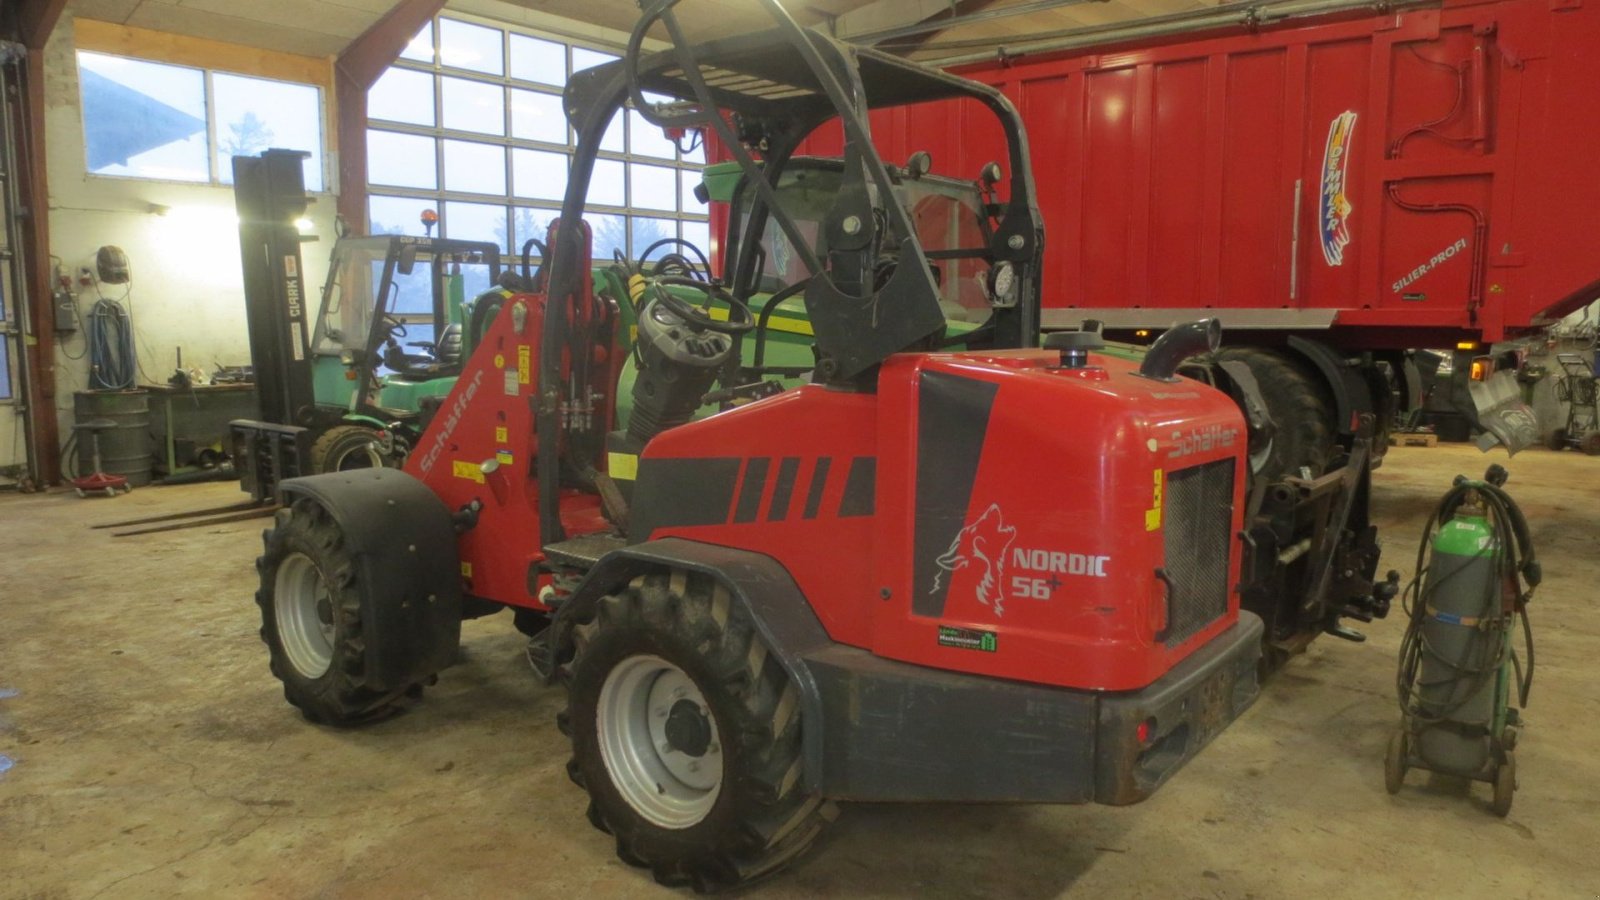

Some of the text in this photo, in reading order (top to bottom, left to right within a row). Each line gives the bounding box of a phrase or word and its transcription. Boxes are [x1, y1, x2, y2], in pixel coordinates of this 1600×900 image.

[1323, 146, 1344, 231] DEMMLER
[1391, 237, 1467, 293] SILIER-PROFI
[286, 279, 301, 318] CLARK
[420, 369, 484, 473] Schäffer
[1167, 423, 1239, 459] Schäffer
[1012, 547, 1111, 577] NORDIC
